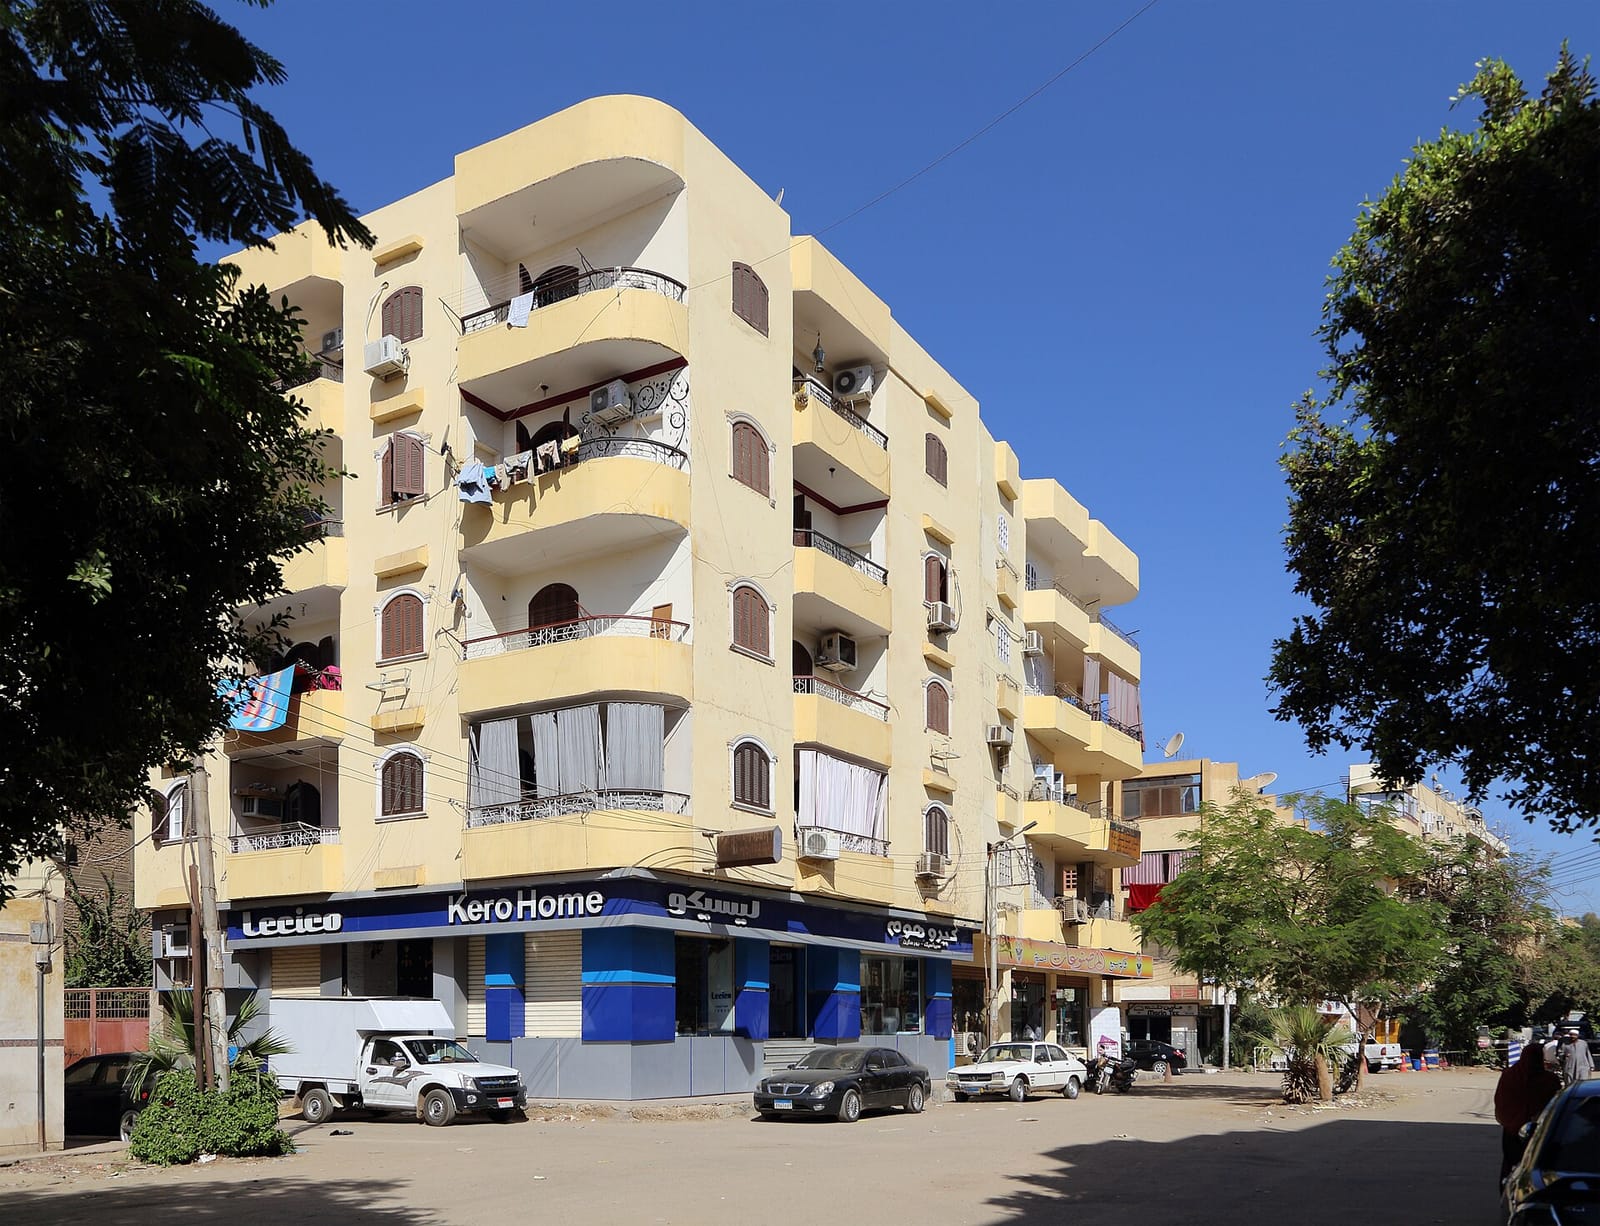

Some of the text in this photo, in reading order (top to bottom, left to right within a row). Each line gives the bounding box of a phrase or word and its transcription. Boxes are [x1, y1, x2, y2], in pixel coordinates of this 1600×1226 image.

[242, 907, 342, 937] Lecico
[448, 889, 603, 924] Kero Home
[666, 890, 760, 926] ليسيكو
[928, 926, 958, 947] كيرو
